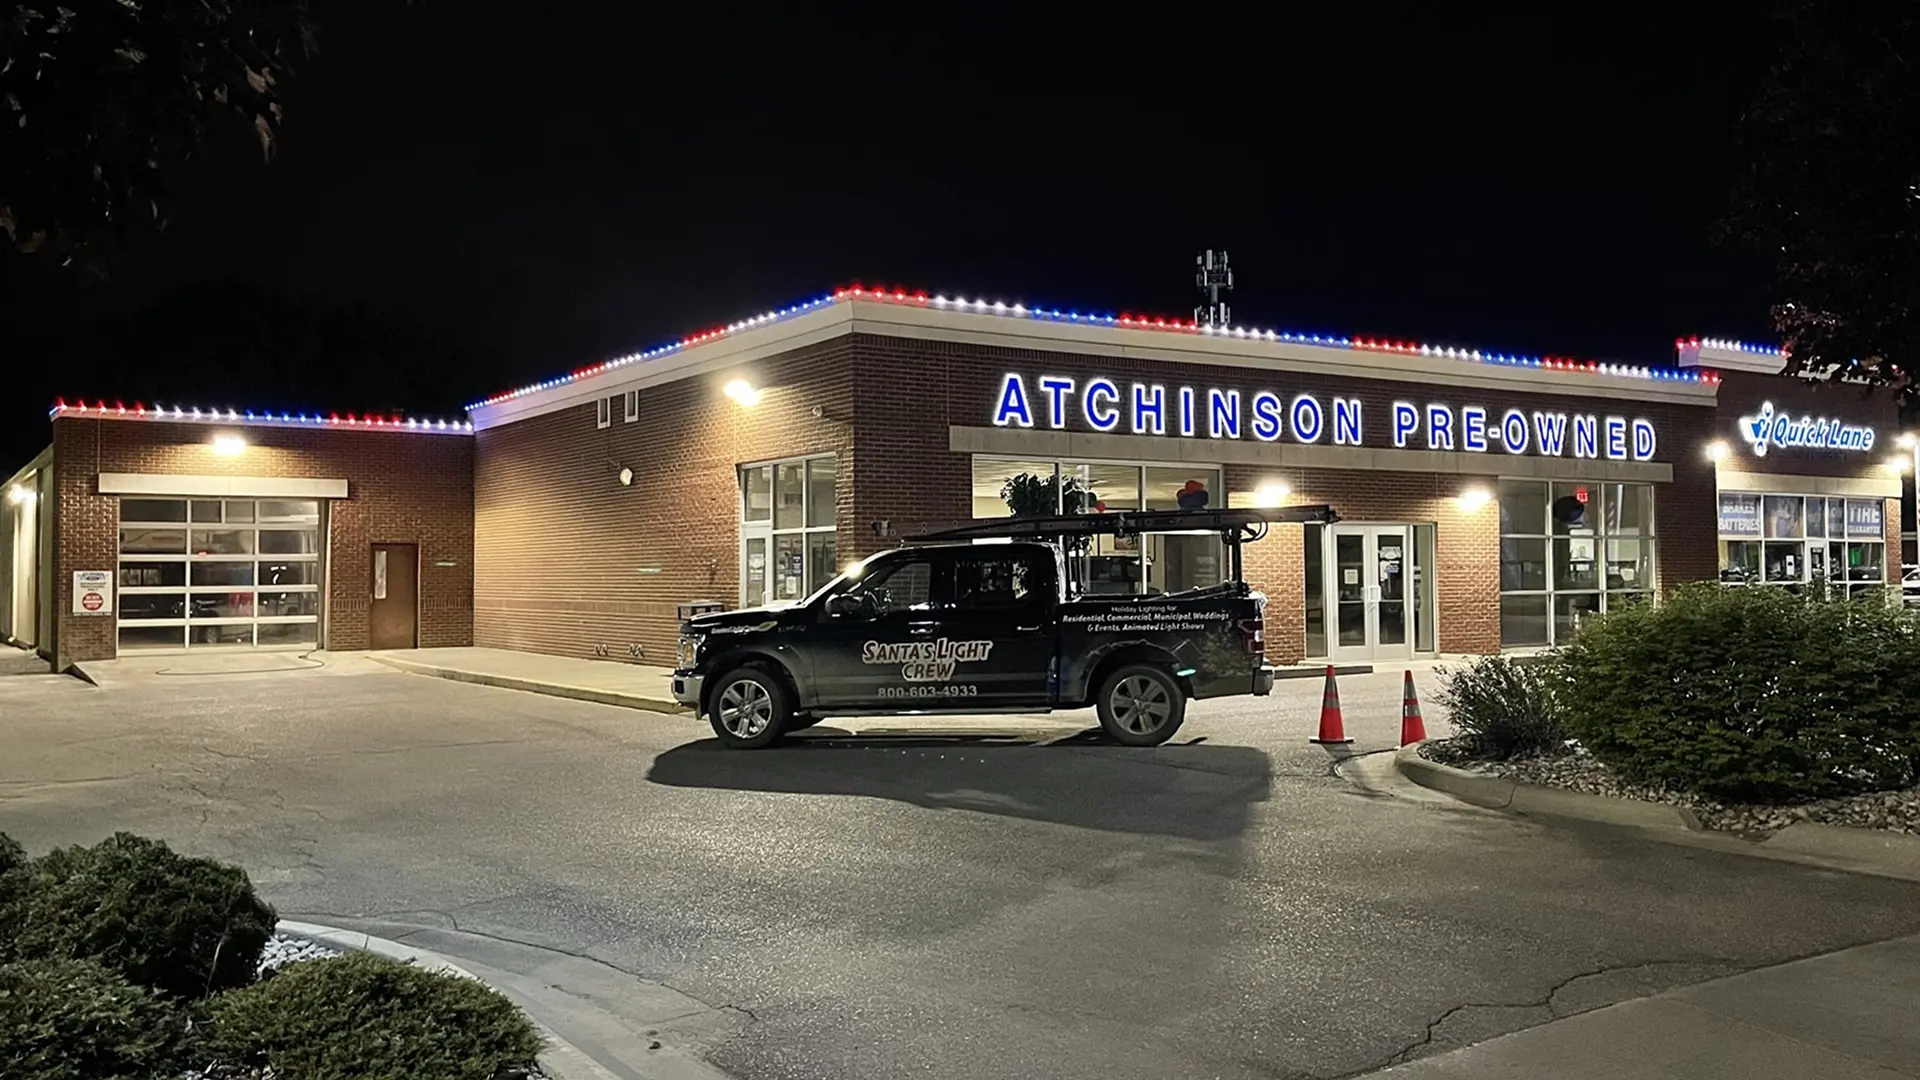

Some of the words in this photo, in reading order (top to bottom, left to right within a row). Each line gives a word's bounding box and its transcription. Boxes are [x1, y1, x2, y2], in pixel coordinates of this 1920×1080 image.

[993, 373, 1362, 446] ATCHINSON
[1393, 402, 1657, 462] PRE-OWNED
[1849, 507, 1880, 523] TIRE
[1719, 518, 1760, 532] BATTERIES
[1138, 605, 1166, 613] Lighting
[1193, 611, 1230, 621] Weddings
[1122, 622, 1160, 631] Animated
[1160, 622, 1180, 632] Light
[1181, 622, 1205, 631] Shows
[862, 640, 936, 664] SANTA'S
[935, 637, 994, 662] LIGHT
[902, 661, 956, 682] CREW
[878, 685, 978, 698] 800-603-4933
